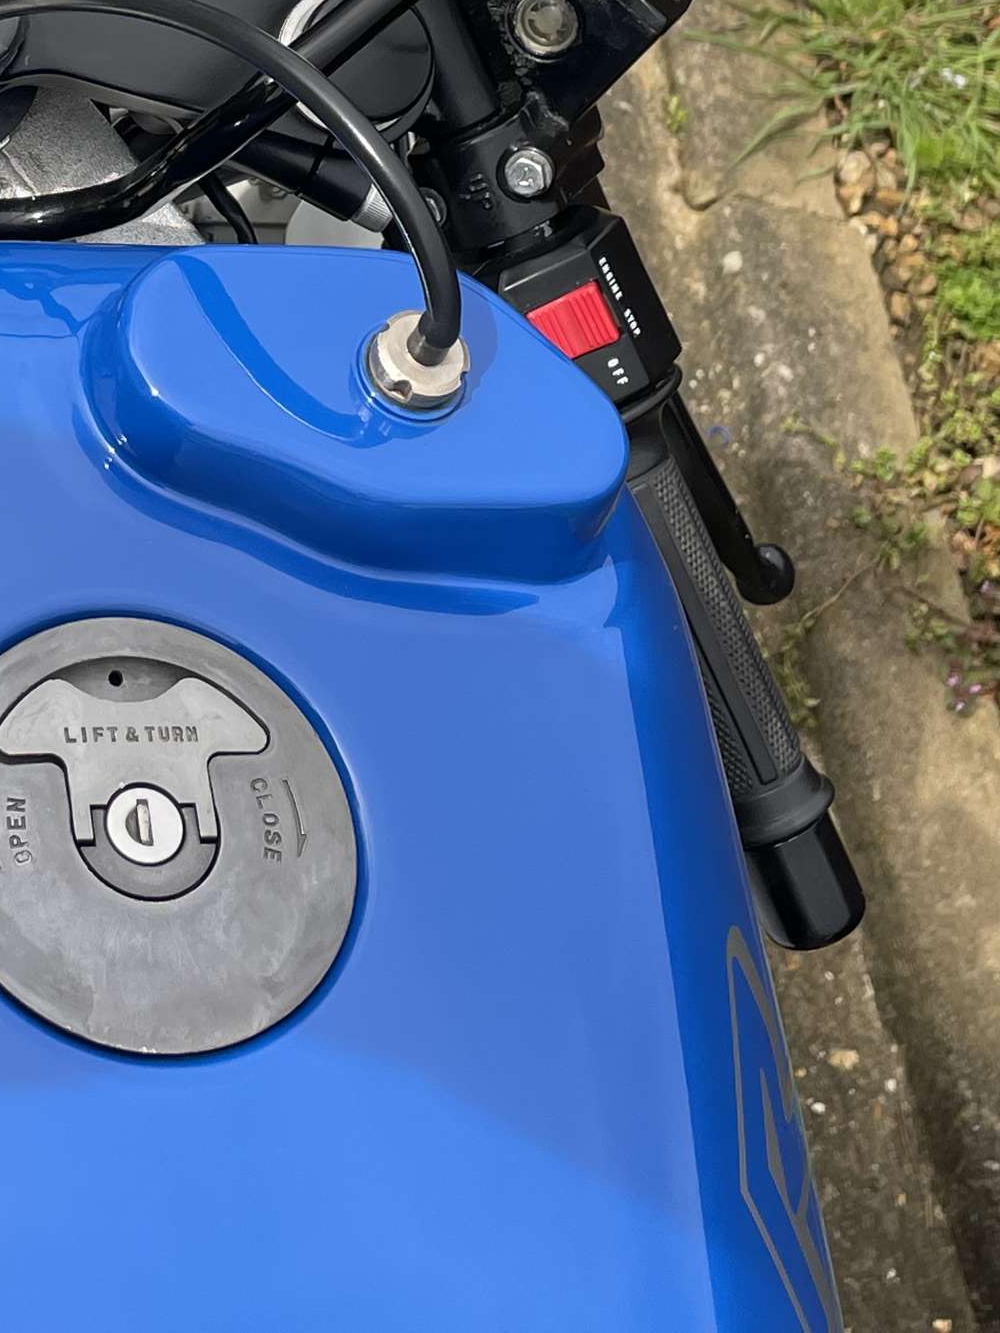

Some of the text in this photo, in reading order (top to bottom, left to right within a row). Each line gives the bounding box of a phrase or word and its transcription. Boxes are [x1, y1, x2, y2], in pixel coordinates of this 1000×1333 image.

[607, 357, 629, 385] OFF
[6, 797, 33, 864] OPEN
[249, 777, 282, 863] CLOSE
